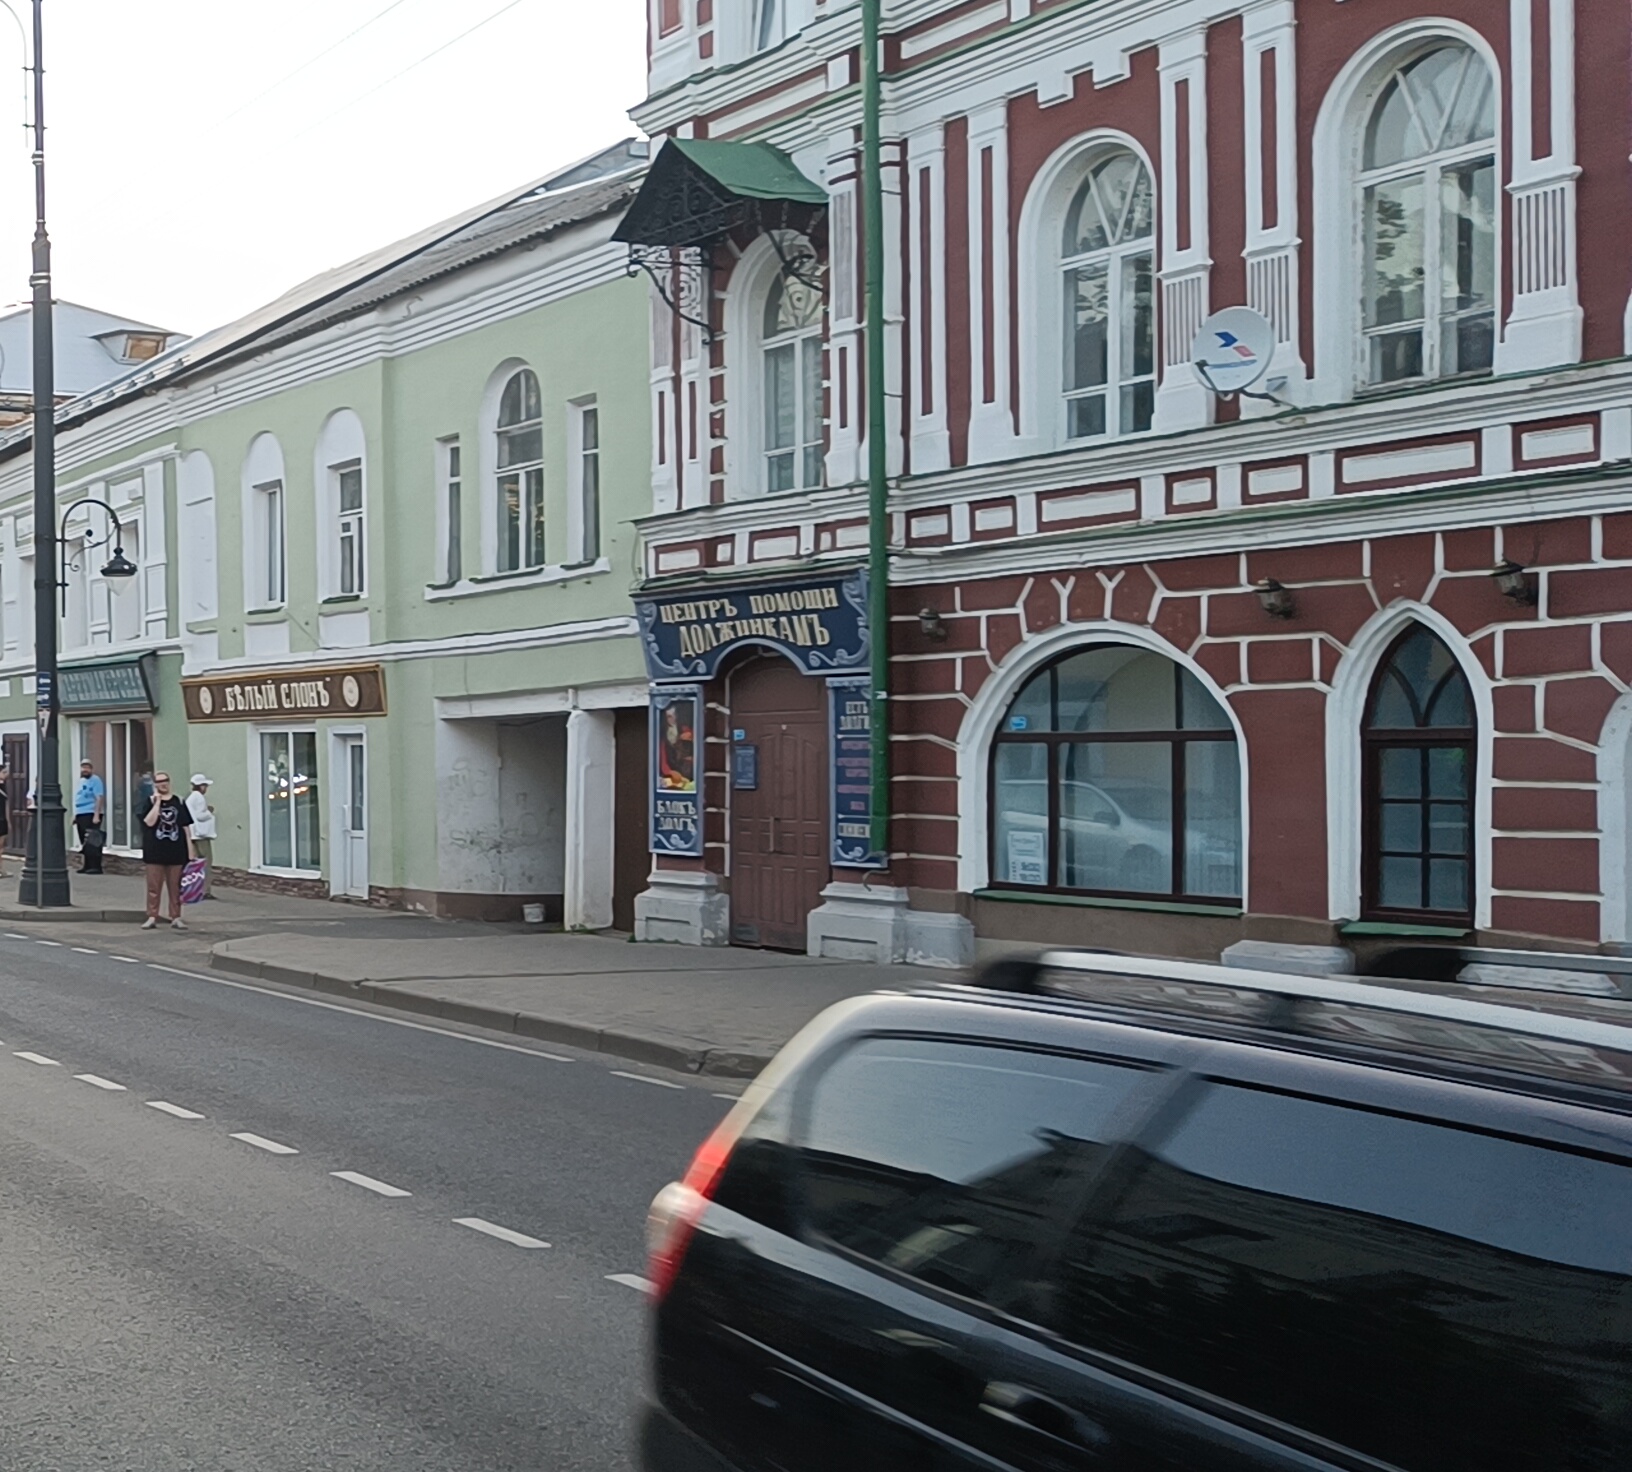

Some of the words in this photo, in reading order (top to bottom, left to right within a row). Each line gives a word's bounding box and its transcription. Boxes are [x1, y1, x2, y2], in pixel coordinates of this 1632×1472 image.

[659, 598, 738, 623] ЦЕНТРЪ
[749, 587, 839, 614] ПОМОЩИ
[679, 613, 831, 658] ДОЛЖНИКАМЪ
